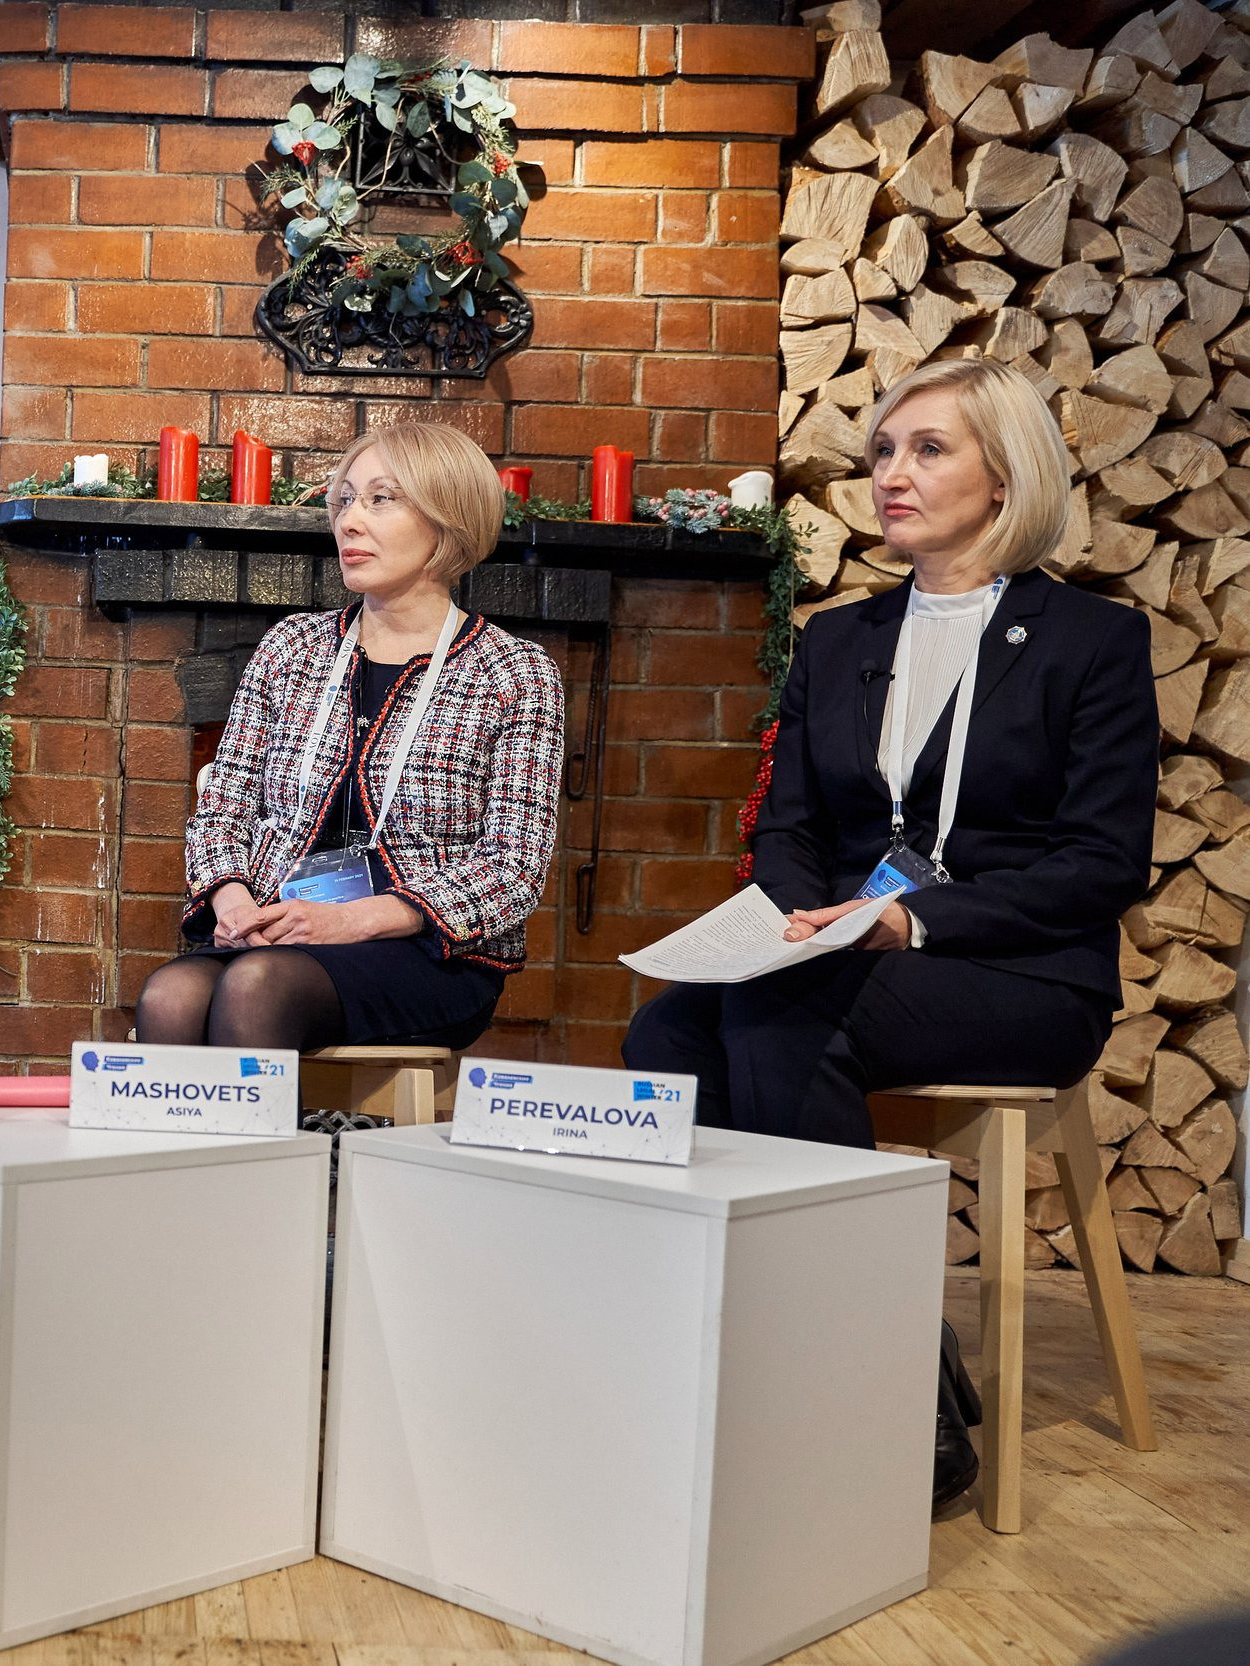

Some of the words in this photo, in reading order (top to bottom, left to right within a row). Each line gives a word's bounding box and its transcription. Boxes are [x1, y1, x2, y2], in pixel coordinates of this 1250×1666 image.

[111, 1081, 261, 1103] MASHOVETS
[167, 1107, 202, 1117] ASIYA
[490, 1098, 658, 1129] PEREVALOVA
[553, 1128, 588, 1140] IRINA
